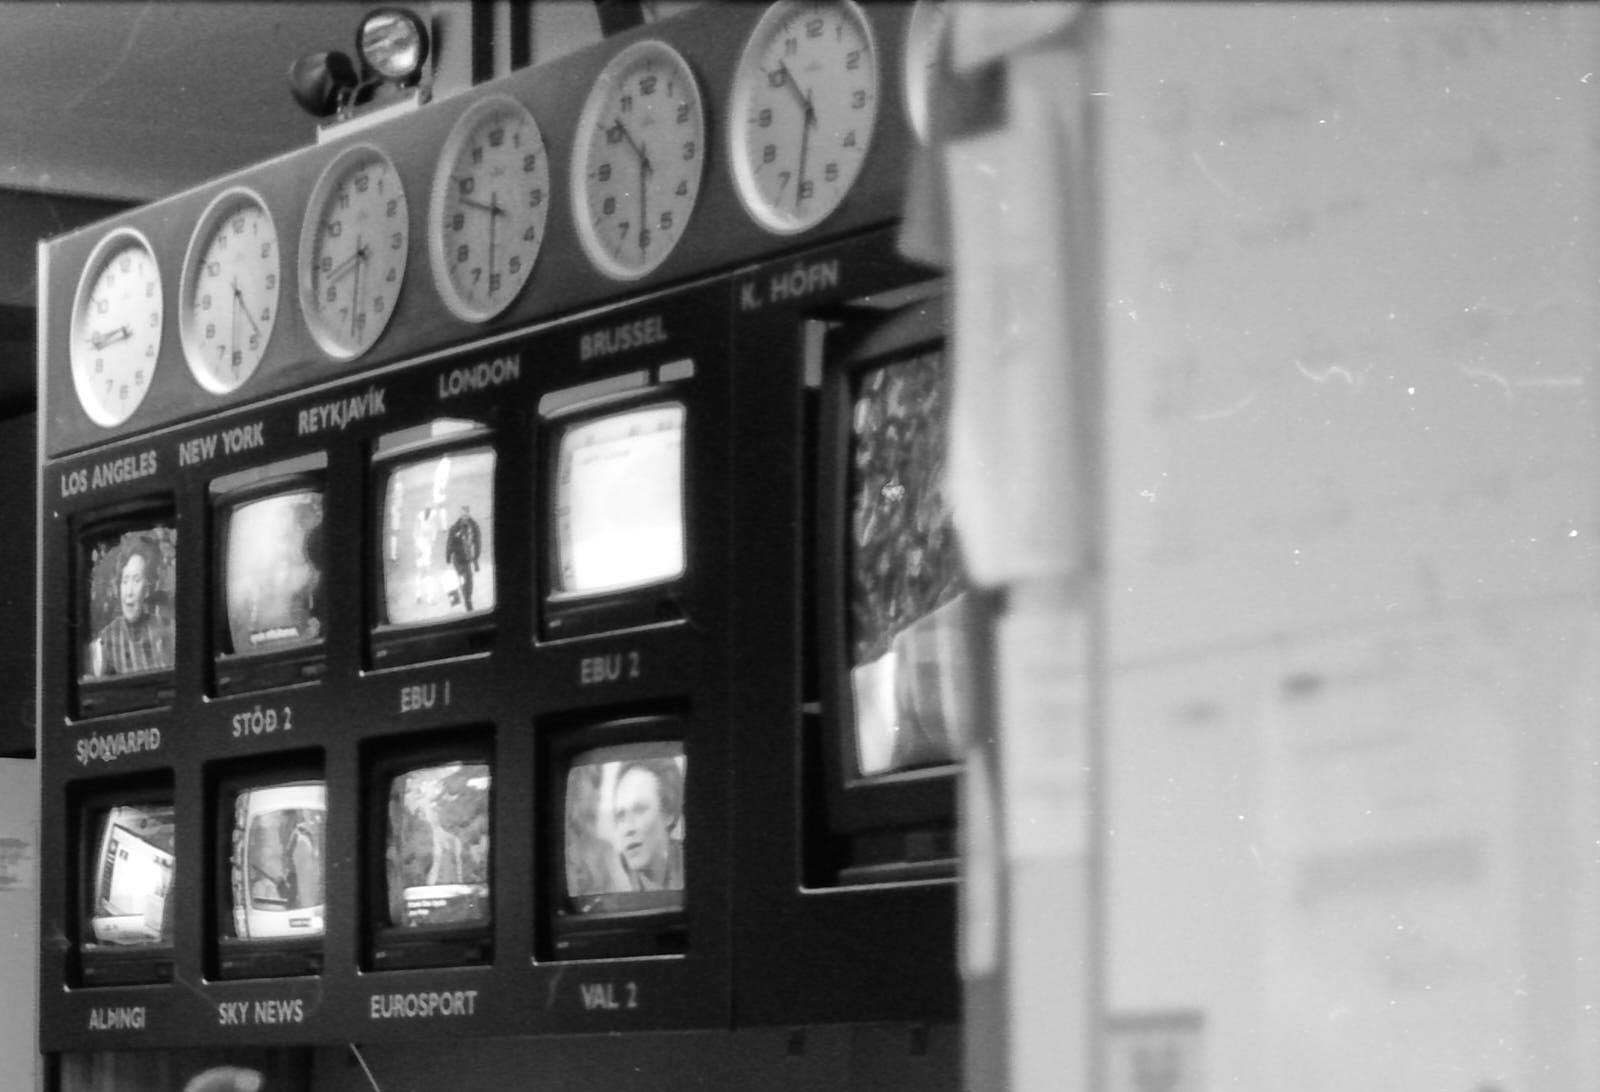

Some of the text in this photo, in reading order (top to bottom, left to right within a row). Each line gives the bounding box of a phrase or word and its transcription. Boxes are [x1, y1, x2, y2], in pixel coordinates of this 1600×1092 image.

[805, 19, 824, 38] 12
[785, 38, 797, 55] 11
[846, 50, 860, 70] 2
[640, 76, 656, 95] 12
[621, 95, 633, 113] 11
[852, 90, 866, 109] 3
[677, 103, 689, 123] 2
[759, 108, 772, 127] 9
[843, 130, 856, 147] 4
[683, 141, 695, 160] 3
[763, 144, 776, 164] 8
[599, 163, 611, 182] 9
[779, 171, 791, 190] 7
[825, 163, 839, 182] 5
[675, 181, 687, 196] 4
[603, 196, 616, 215] 8
[619, 221, 630, 239] 7
[660, 211, 672, 230] 5
[770, 259, 839, 303] HÖFN
[580, 316, 667, 361] BRUSSEL
[439, 354, 520, 399] LONDON
[299, 385, 386, 436] REYKJAVÍK
[179, 421, 264, 467] NEW YORK
[61, 449, 157, 498] LOS ANGELES
[580, 651, 640, 685] EBU 2
[400, 683, 437, 713] EBU
[283, 706, 292, 730] 2
[369, 990, 478, 1018] EUROSPORT
[580, 981, 638, 1010] VAL 2
[88, 1006, 146, 1030] ALÞINGI
[218, 999, 303, 1025] SKY NEWS
